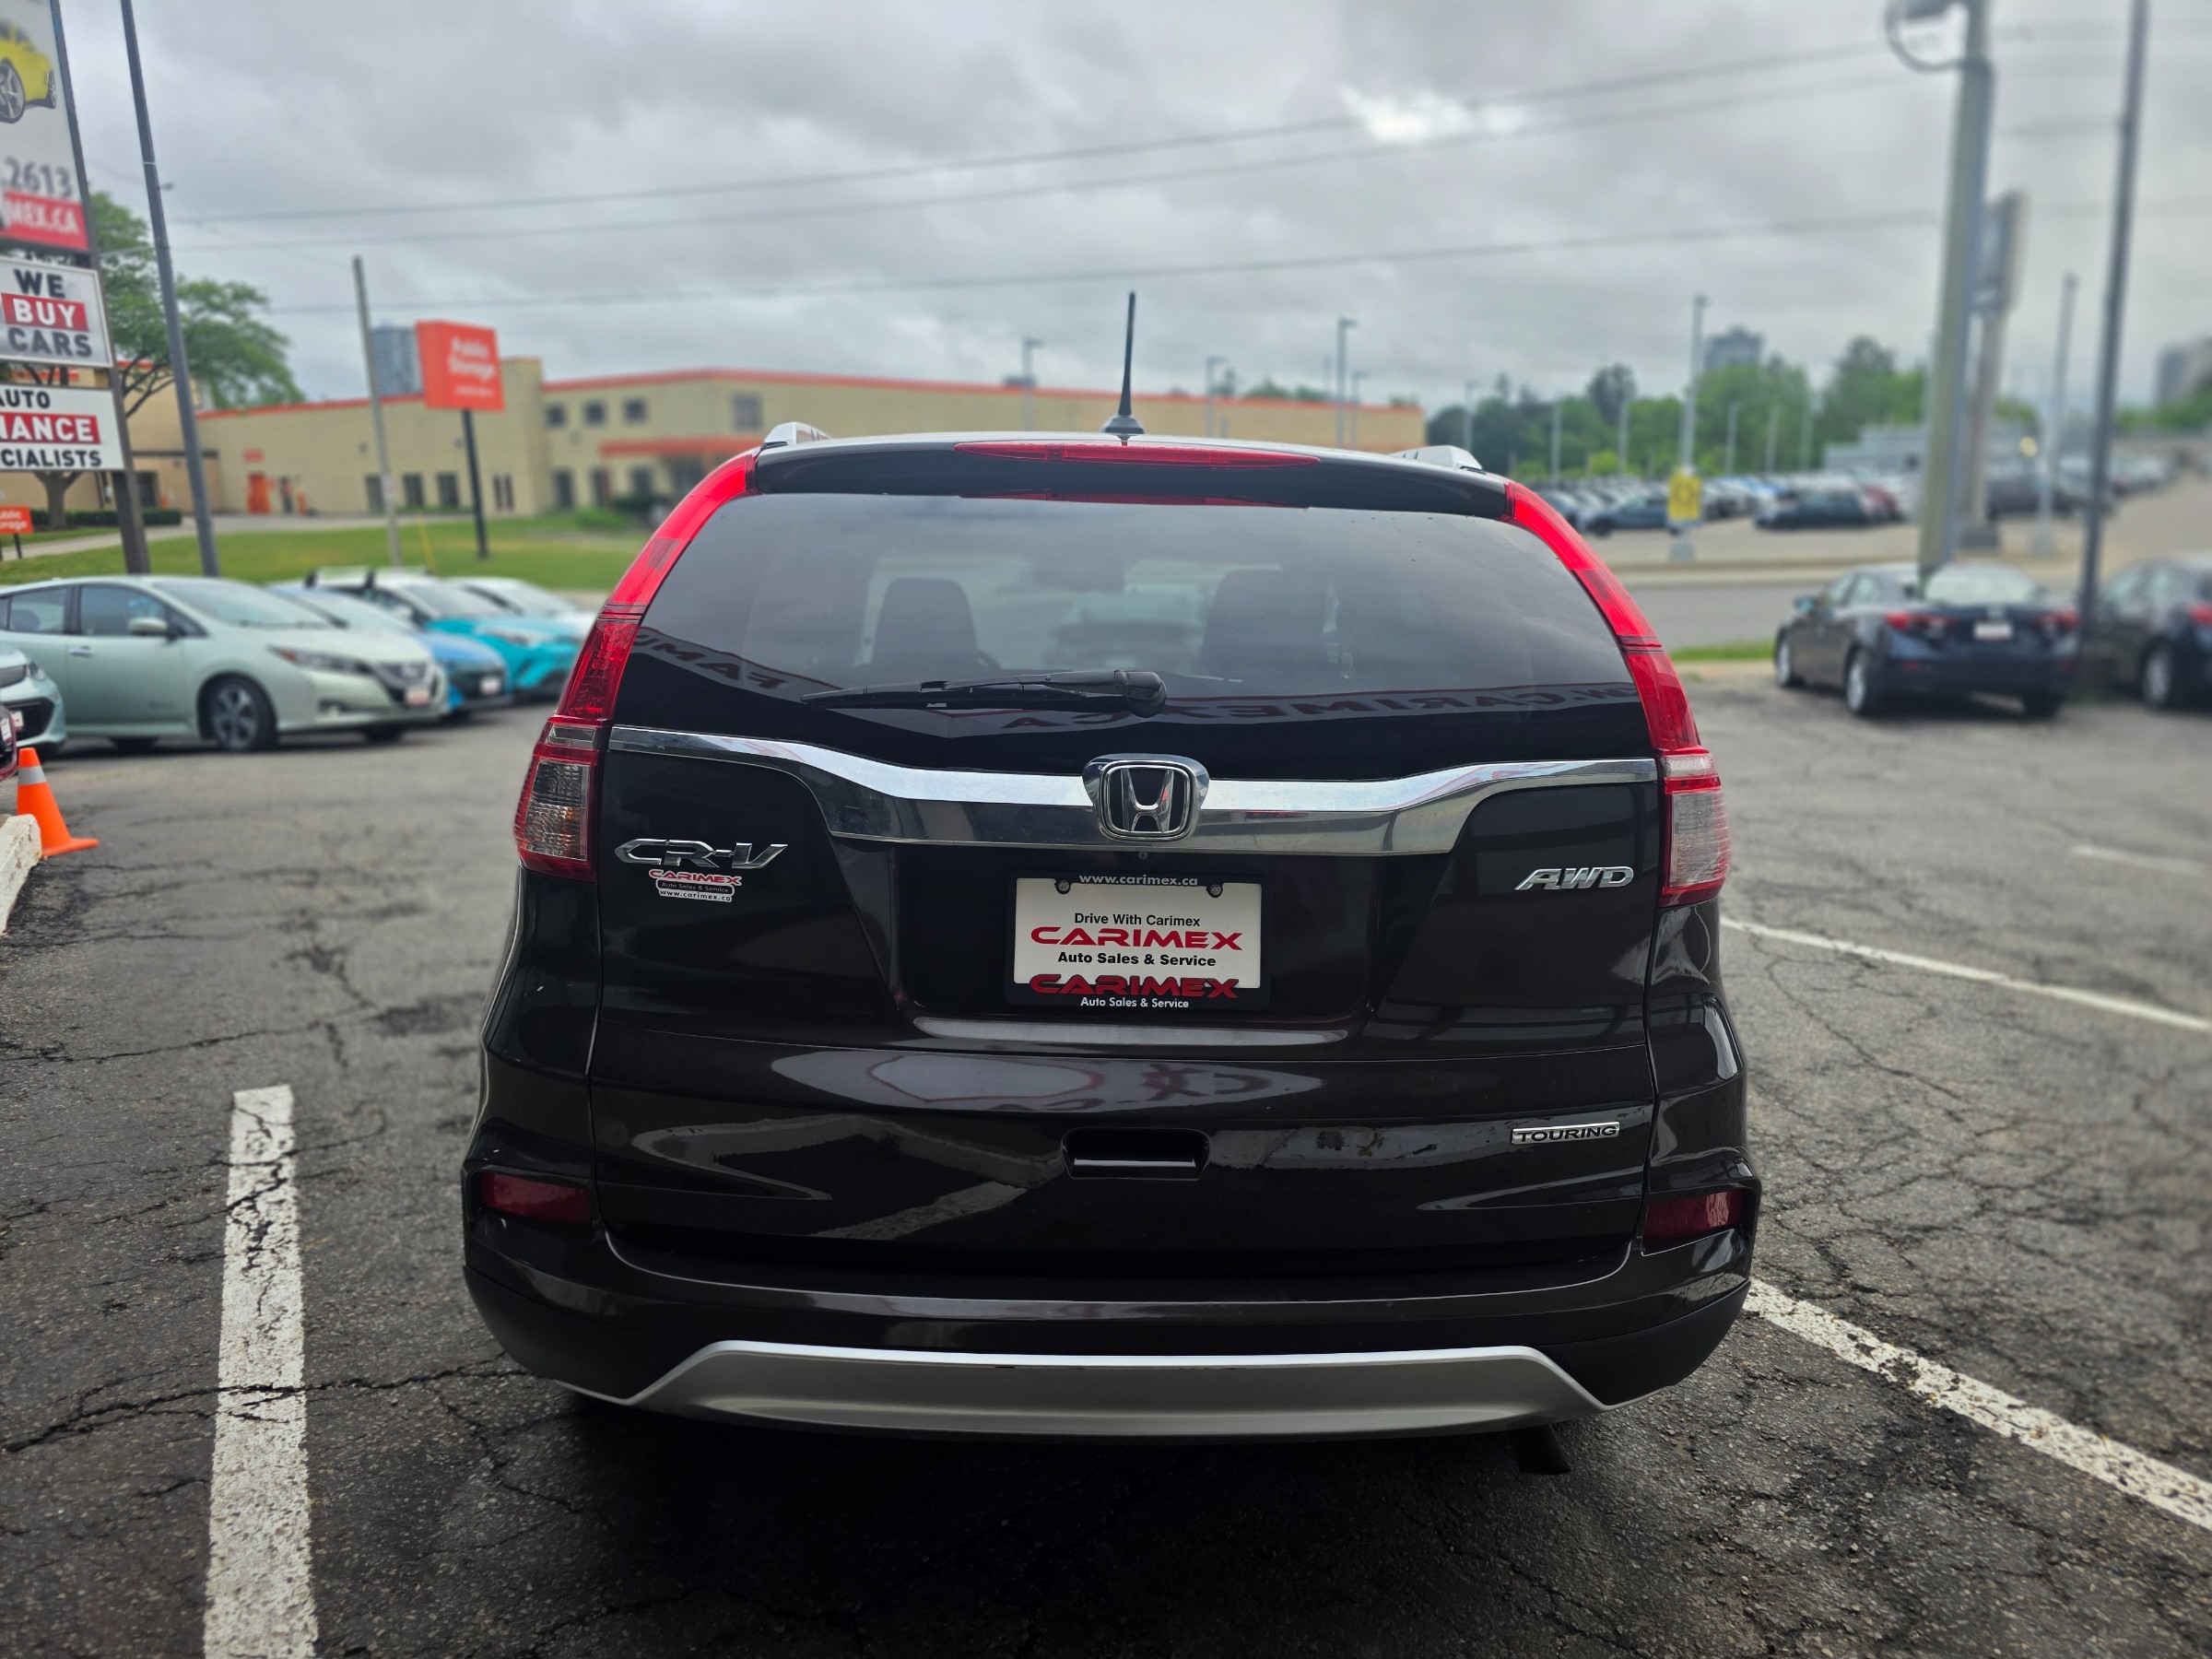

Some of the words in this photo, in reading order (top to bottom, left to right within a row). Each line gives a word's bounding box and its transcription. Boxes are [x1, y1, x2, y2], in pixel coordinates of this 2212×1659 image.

[14, 268, 65, 299] WE
[12, 298, 76, 328] BUY
[7, 327, 92, 358] CARS
[615, 838, 788, 869] CR-V
[649, 870, 740, 884] CARIMEX
[1078, 874, 1198, 886] www.carimex.ca
[1514, 865, 1634, 890] AWD
[660, 890, 731, 901] www.carimex.ca
[1074, 912, 1109, 924] Drive
[1112, 913, 1142, 925] With
[1146, 914, 1201, 926] Carimex
[1030, 926, 1242, 950] CARIMEX
[1057, 951, 1093, 964] Auto
[1097, 953, 1139, 965] Sales
[1143, 954, 1155, 965] &
[1159, 955, 1217, 967] Service
[1029, 973, 1240, 998] CARIMEX
[1080, 996, 1106, 1007] Auto
[1109, 997, 1137, 1008] Sales
[1140, 998, 1148, 1008] &
[1151, 998, 1190, 1009] Service
[1517, 1125, 1618, 1143] TOURING
